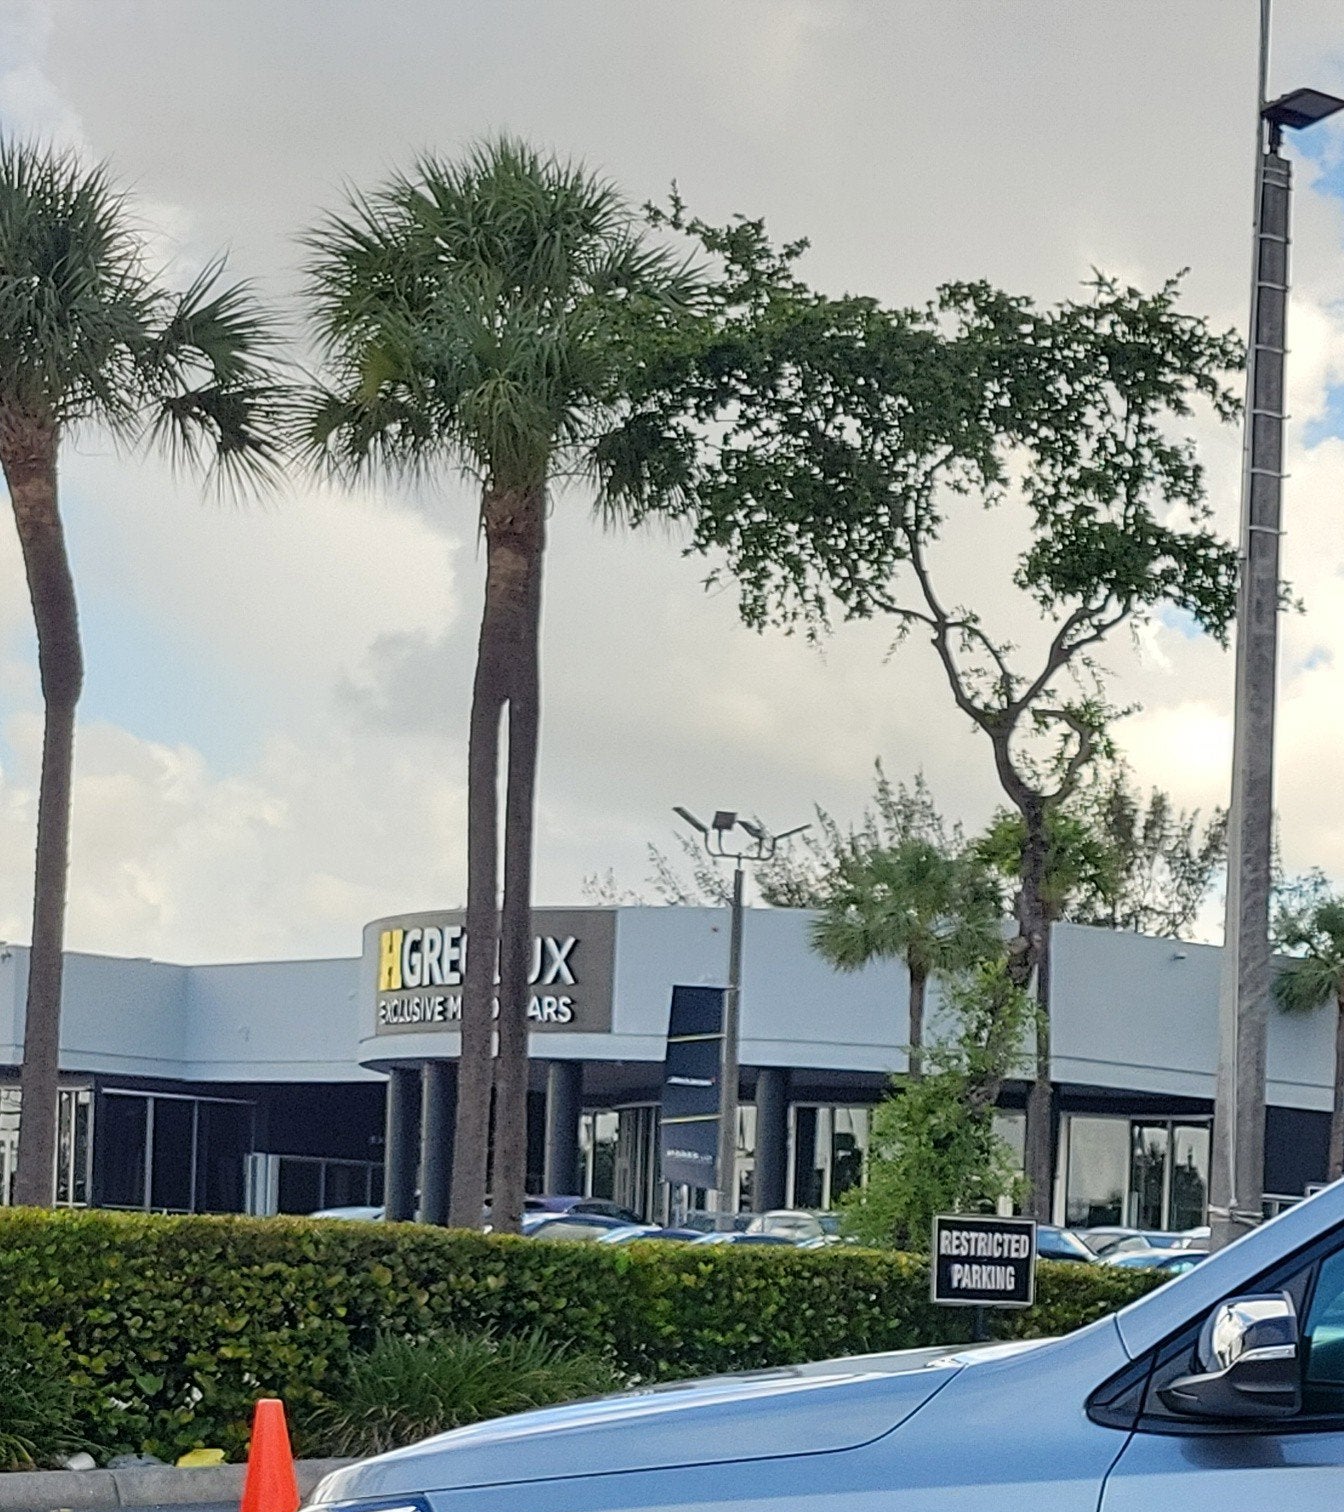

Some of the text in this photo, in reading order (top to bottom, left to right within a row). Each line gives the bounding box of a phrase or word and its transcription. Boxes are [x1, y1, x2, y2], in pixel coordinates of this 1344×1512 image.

[379, 996, 444, 1025] EXCLUSIVE
[940, 1230, 1030, 1258] RESTRICTED
[951, 1263, 1016, 1291] PARKING
